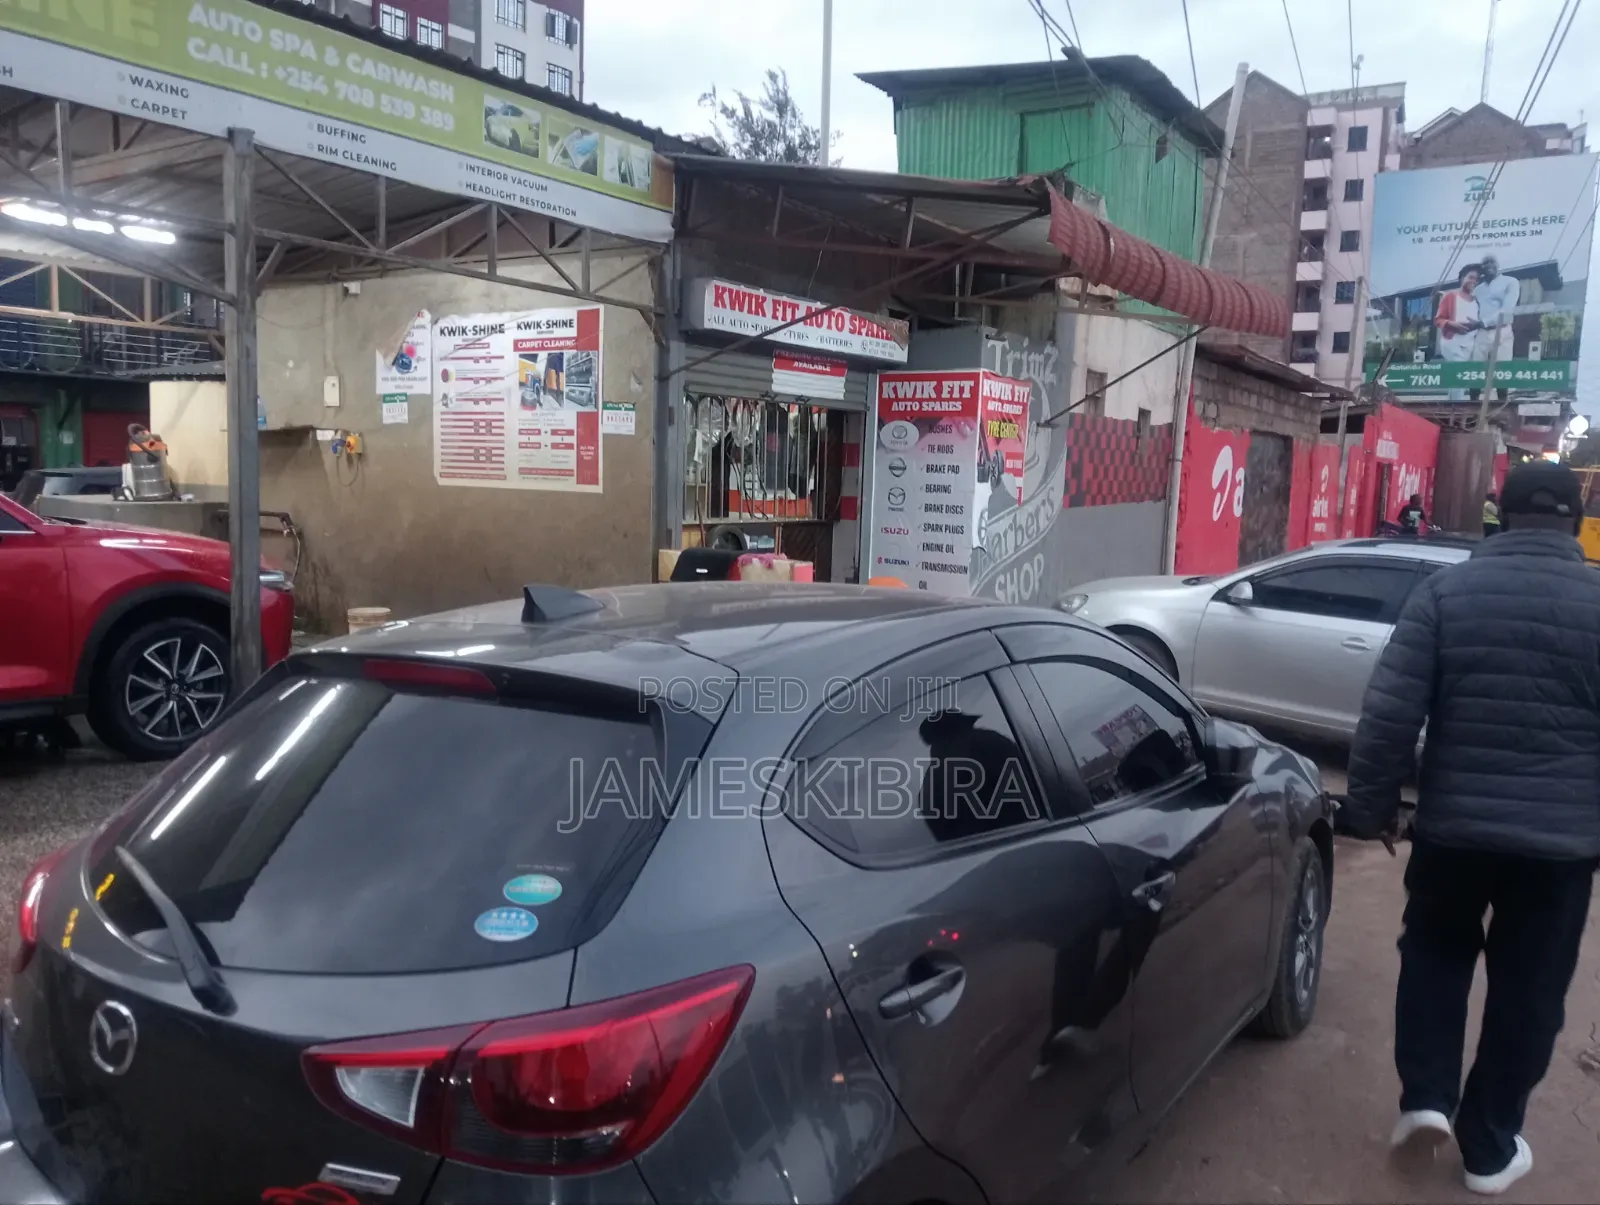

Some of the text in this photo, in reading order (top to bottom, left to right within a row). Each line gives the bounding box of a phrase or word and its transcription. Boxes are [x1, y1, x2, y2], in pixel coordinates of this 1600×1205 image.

[187, 2, 455, 104] AUTO SPA & CARWASH
[128, 73, 190, 99] WAXING
[186, 36, 256, 76] CALL
[273, 64, 329, 97] +254
[333, 78, 375, 109] 708
[379, 91, 416, 121] 539
[419, 104, 455, 132] 389
[130, 98, 189, 121] CARPET
[316, 122, 368, 146] BUFFING
[316, 143, 398, 173] RIM CLEANING
[465, 162, 549, 193] INTERIOR VACUUM
[465, 181, 578, 218] HEADLIGHT RESTORATION
[1397, 214, 1566, 236] YOUR FUTURE BEGINS HERE
[1429, 234, 1452, 244] ACRE
[1453, 232, 1481, 243] PLOTS
[1482, 231, 1509, 241] FROM
[1510, 230, 1527, 239] KES
[1528, 228, 1543, 238] 3M
[713, 284, 768, 318] KWIK
[771, 298, 800, 324] FIT
[802, 305, 846, 333] AUTO
[712, 314, 726, 326] ALL
[728, 319, 749, 330] AUTO
[787, 330, 810, 341] TYRES
[818, 335, 853, 349] BATTERIES
[517, 339, 577, 350] CARPET CLEANING
[792, 361, 832, 372] AVAILABLE
[1410, 374, 1441, 387] 7KM
[1456, 370, 1485, 381] +254
[1515, 370, 1538, 381] 441
[1540, 369, 1564, 380] 441
[882, 380, 974, 399] KWIK FIT
[983, 378, 1031, 403] KWIK FIT
[892, 401, 962, 412] AUTO SPARES
[928, 424, 953, 435] BUSHES
[987, 420, 999, 438] TYRE
[927, 444, 954, 455] TIE RODS
[925, 464, 960, 475] BRAKE PAD
[925, 483, 952, 495] BEARING
[924, 503, 964, 516] BRAKE DISCS
[880, 527, 909, 536] ISUZU
[922, 523, 965, 536] SPARK PLUGS
[922, 542, 955, 554] ENGINE OIL
[884, 557, 910, 567] SUZUKI
[921, 561, 968, 575] TRANSMISSION
[918, 580, 928, 591] OIL
[994, 553, 1044, 603] SHOP
